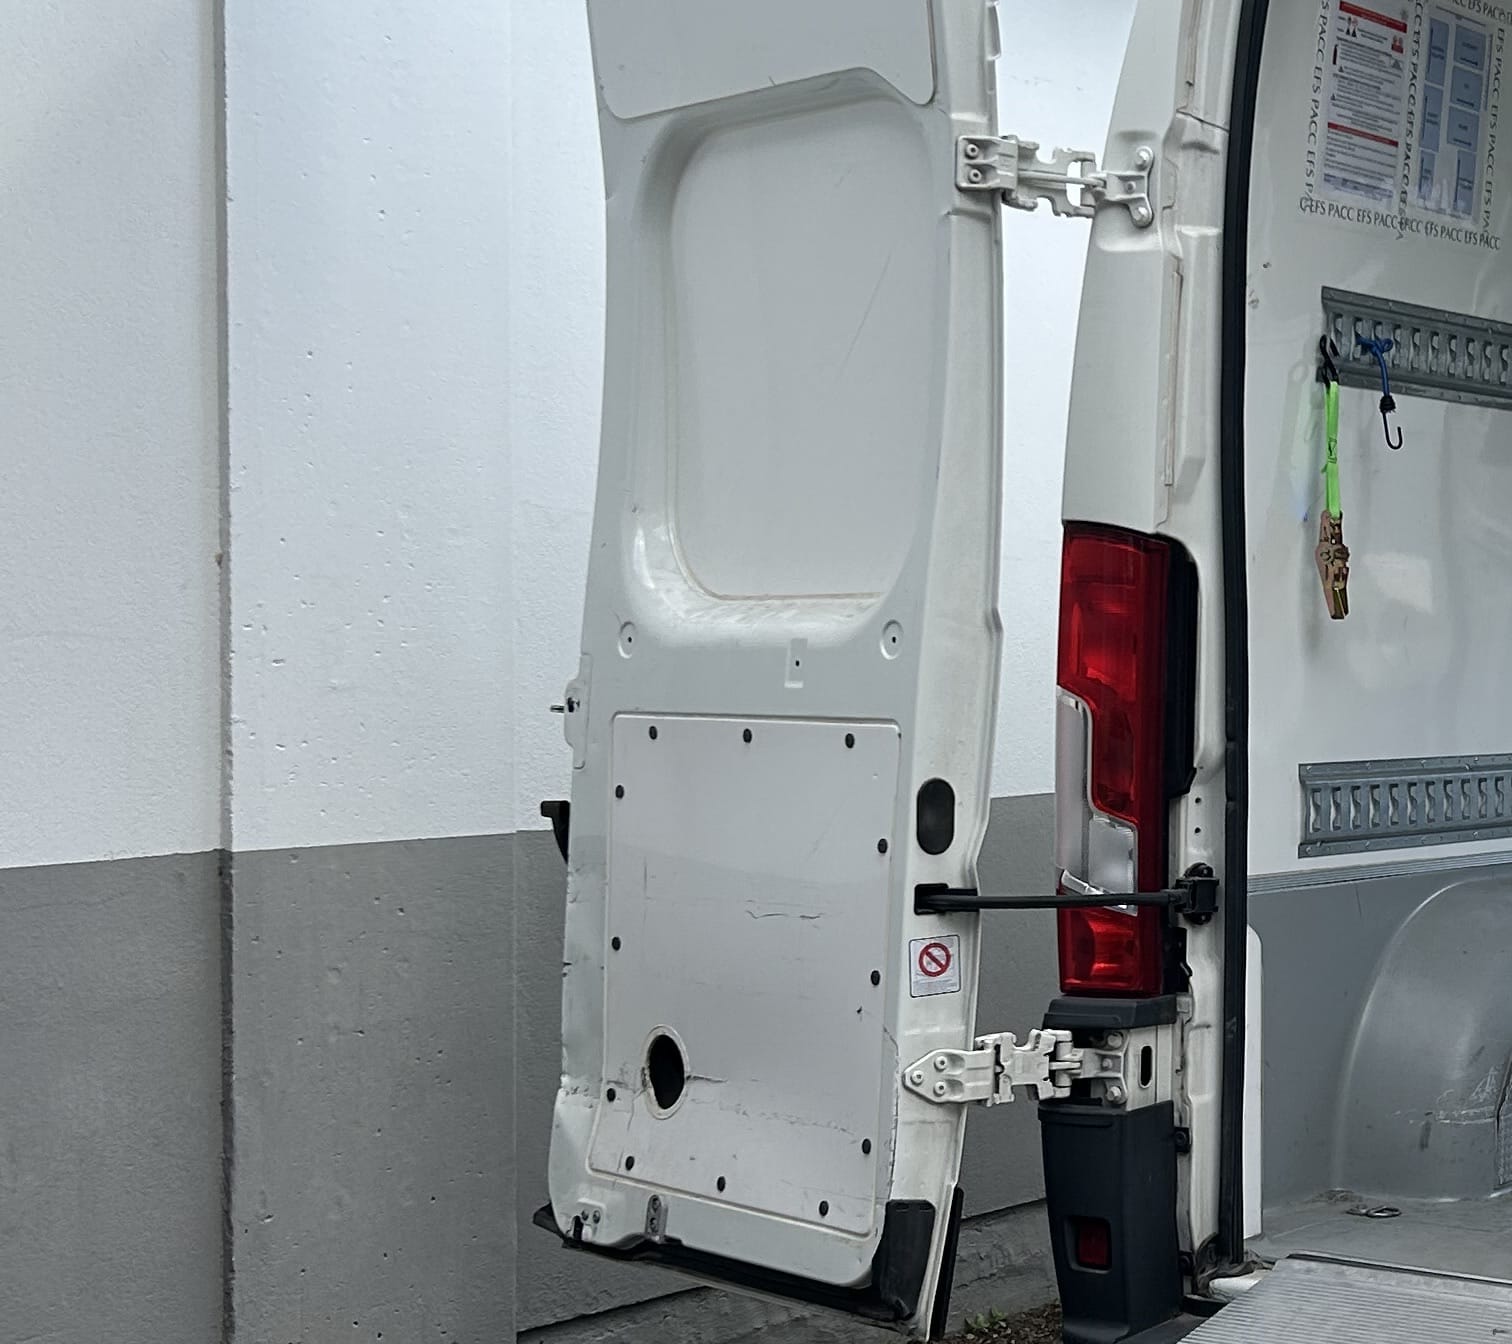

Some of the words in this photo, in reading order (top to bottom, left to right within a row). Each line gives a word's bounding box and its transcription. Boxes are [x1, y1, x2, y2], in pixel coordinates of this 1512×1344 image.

[1316, 14, 1328, 61] PACC
[1307, 98, 1319, 145] PACC
[1328, 203, 1355, 221] PACC
[1356, 208, 1372, 225] EFS
